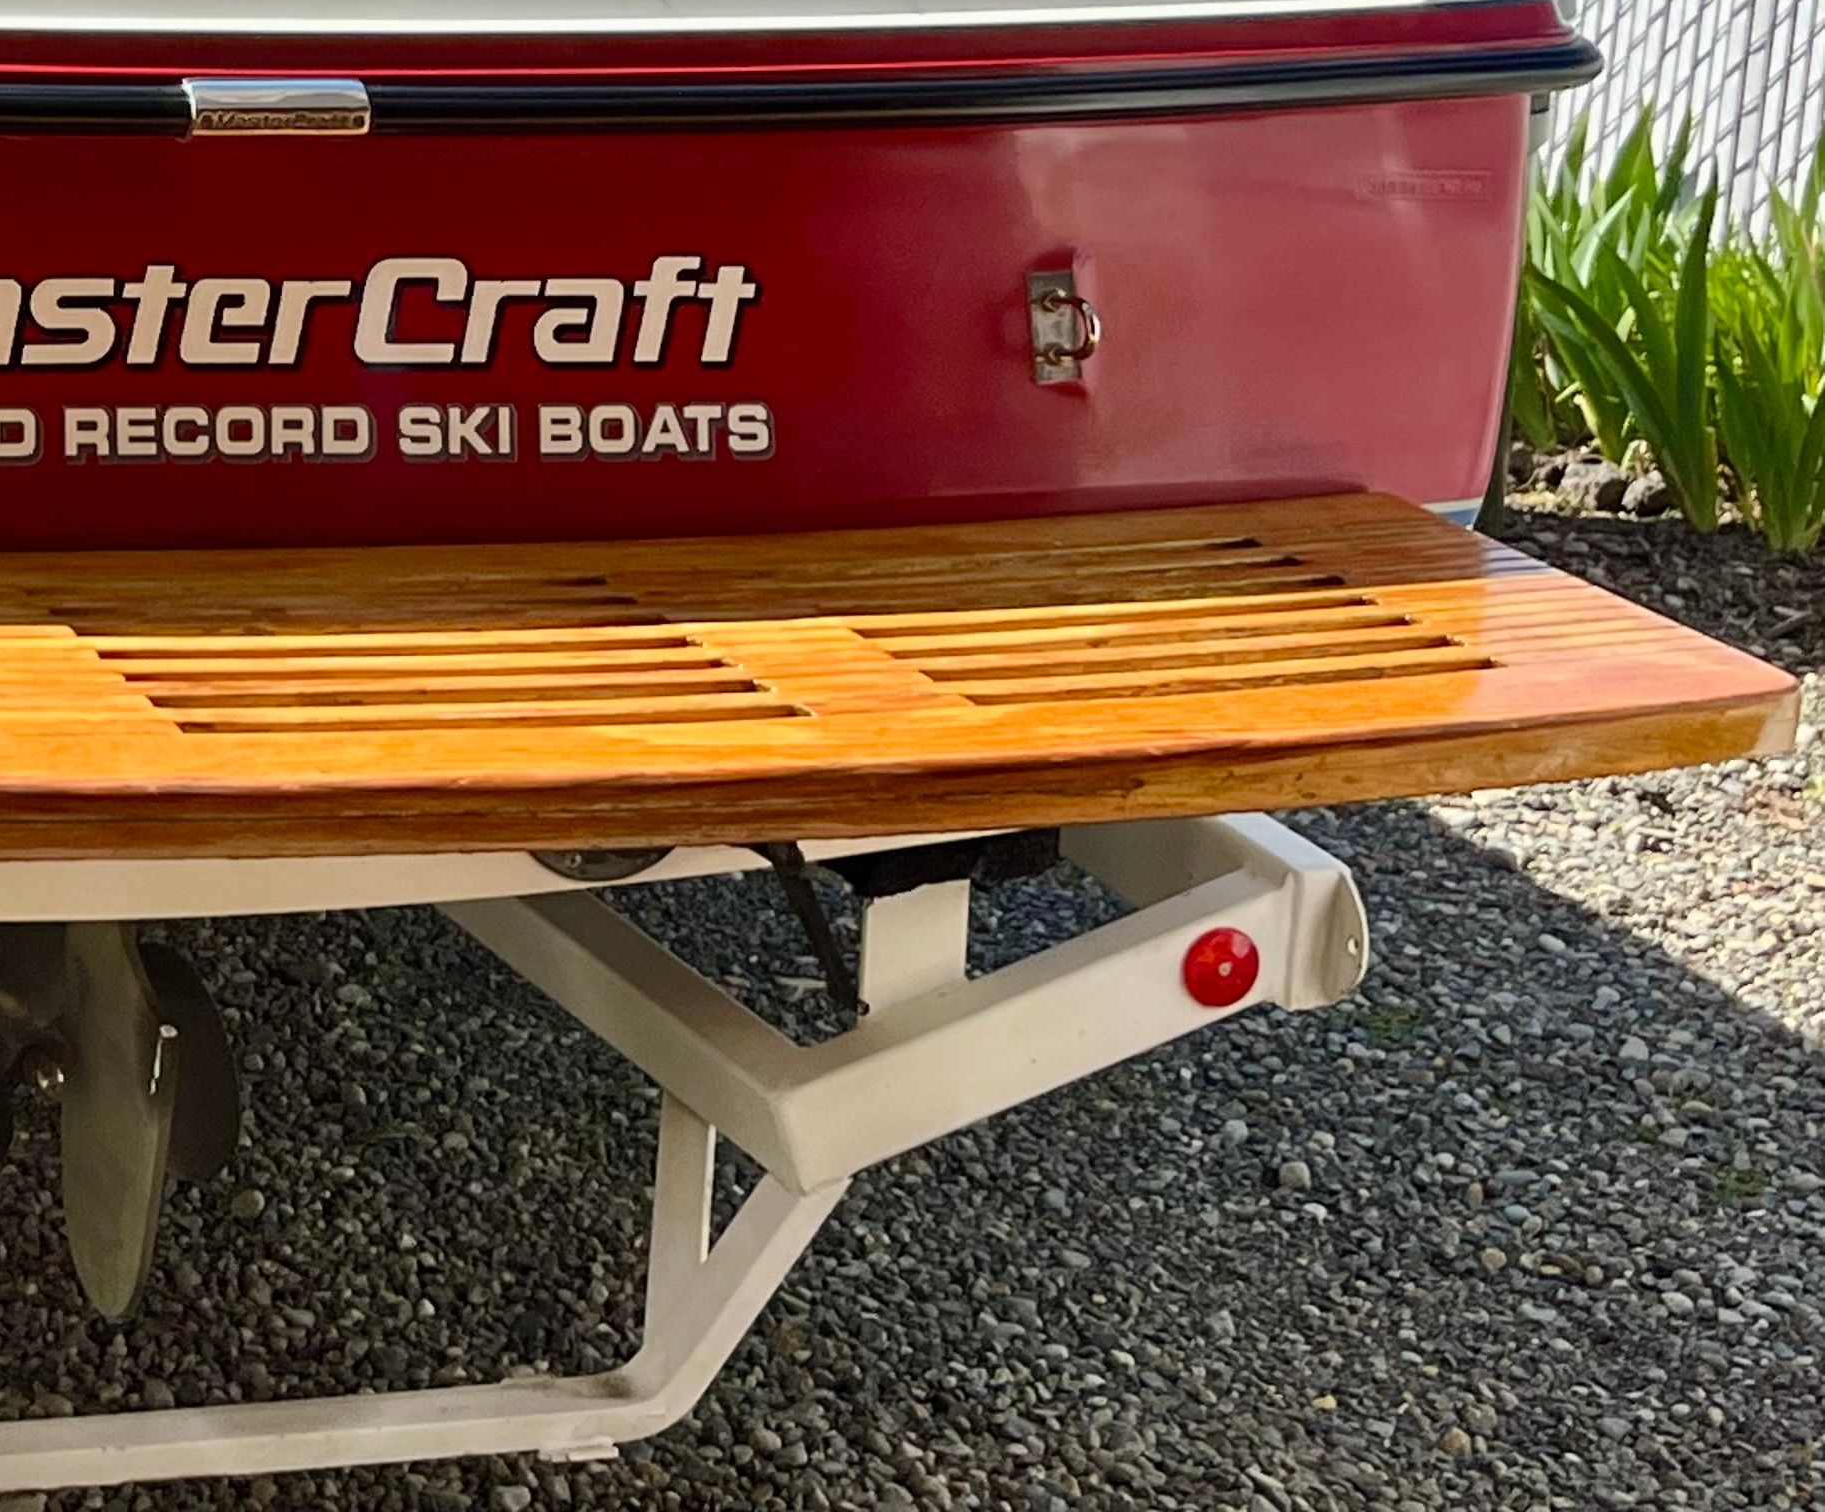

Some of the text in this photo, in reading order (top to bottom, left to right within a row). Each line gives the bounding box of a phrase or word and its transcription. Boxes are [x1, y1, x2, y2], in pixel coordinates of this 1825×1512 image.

[64, 404, 376, 462] RECORD
[397, 402, 517, 461] SKI
[538, 401, 774, 460] BOATS
